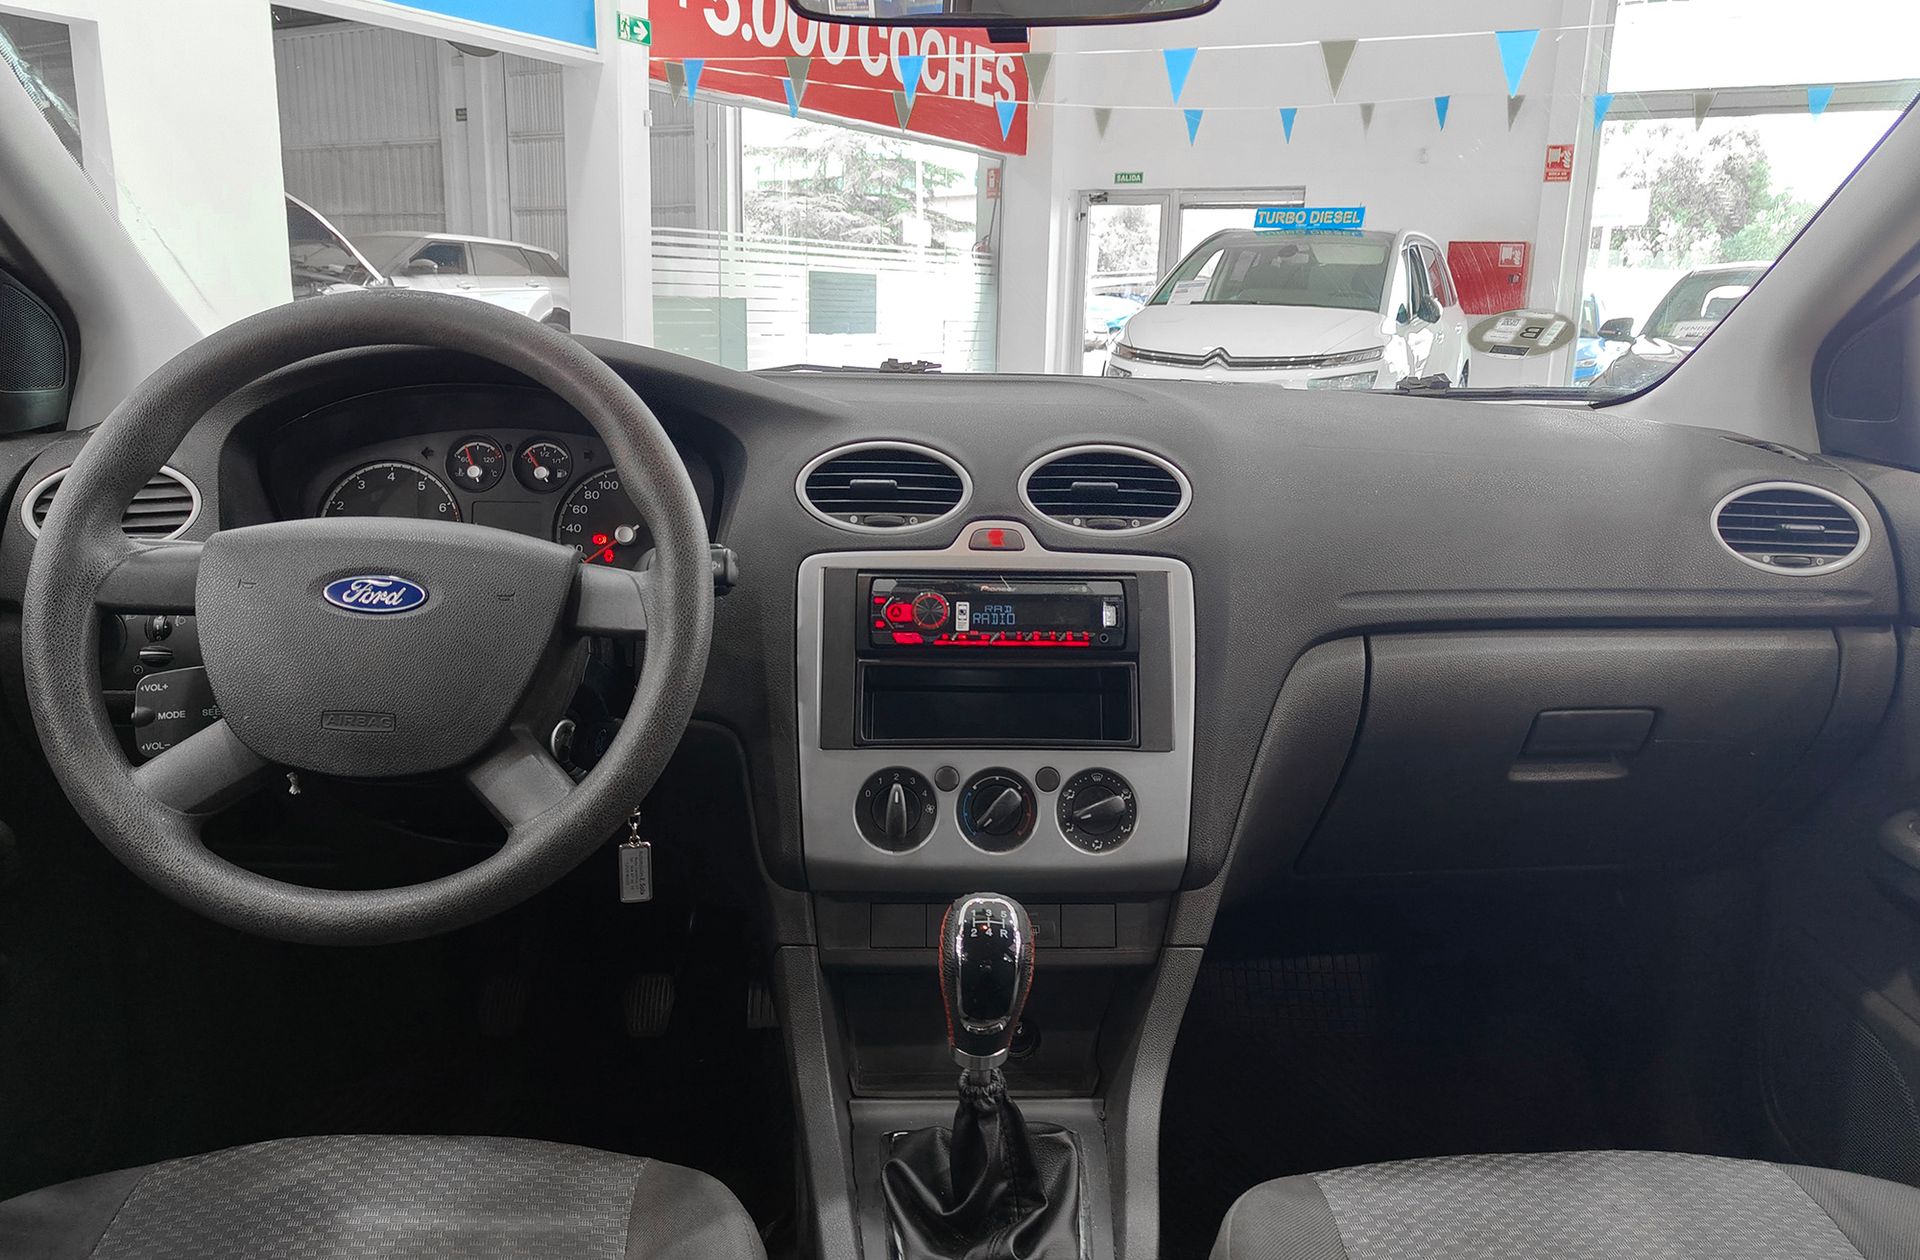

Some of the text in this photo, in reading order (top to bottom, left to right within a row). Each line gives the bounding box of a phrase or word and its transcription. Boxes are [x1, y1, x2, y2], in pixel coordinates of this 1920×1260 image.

[858, 25, 1016, 107] COCHES
[1258, 210, 1361, 224] TURBO DIESEL
[387, 472, 396, 481] 4
[358, 480, 366, 490] 3
[418, 481, 426, 491] 5
[599, 480, 619, 490] 100
[584, 490, 600, 500] 80
[336, 501, 345, 511] 2
[438, 502, 447, 513] 6
[572, 504, 588, 515] 60
[565, 523, 582, 533] 40
[342, 579, 407, 606] Ford
[984, 604, 1012, 613] RAD
[972, 612, 1016, 625] RADIO
[144, 683, 169, 692] VOL+
[157, 710, 186, 720] MODE
[326, 714, 393, 728] AIRBAG
[894, 773, 900, 781] 2
[910, 777, 916, 785] 3
[865, 790, 871, 798] 0
[922, 790, 928, 798] 4
[985, 909, 992, 917] 3
[970, 928, 1008, 938] 2 4 R
